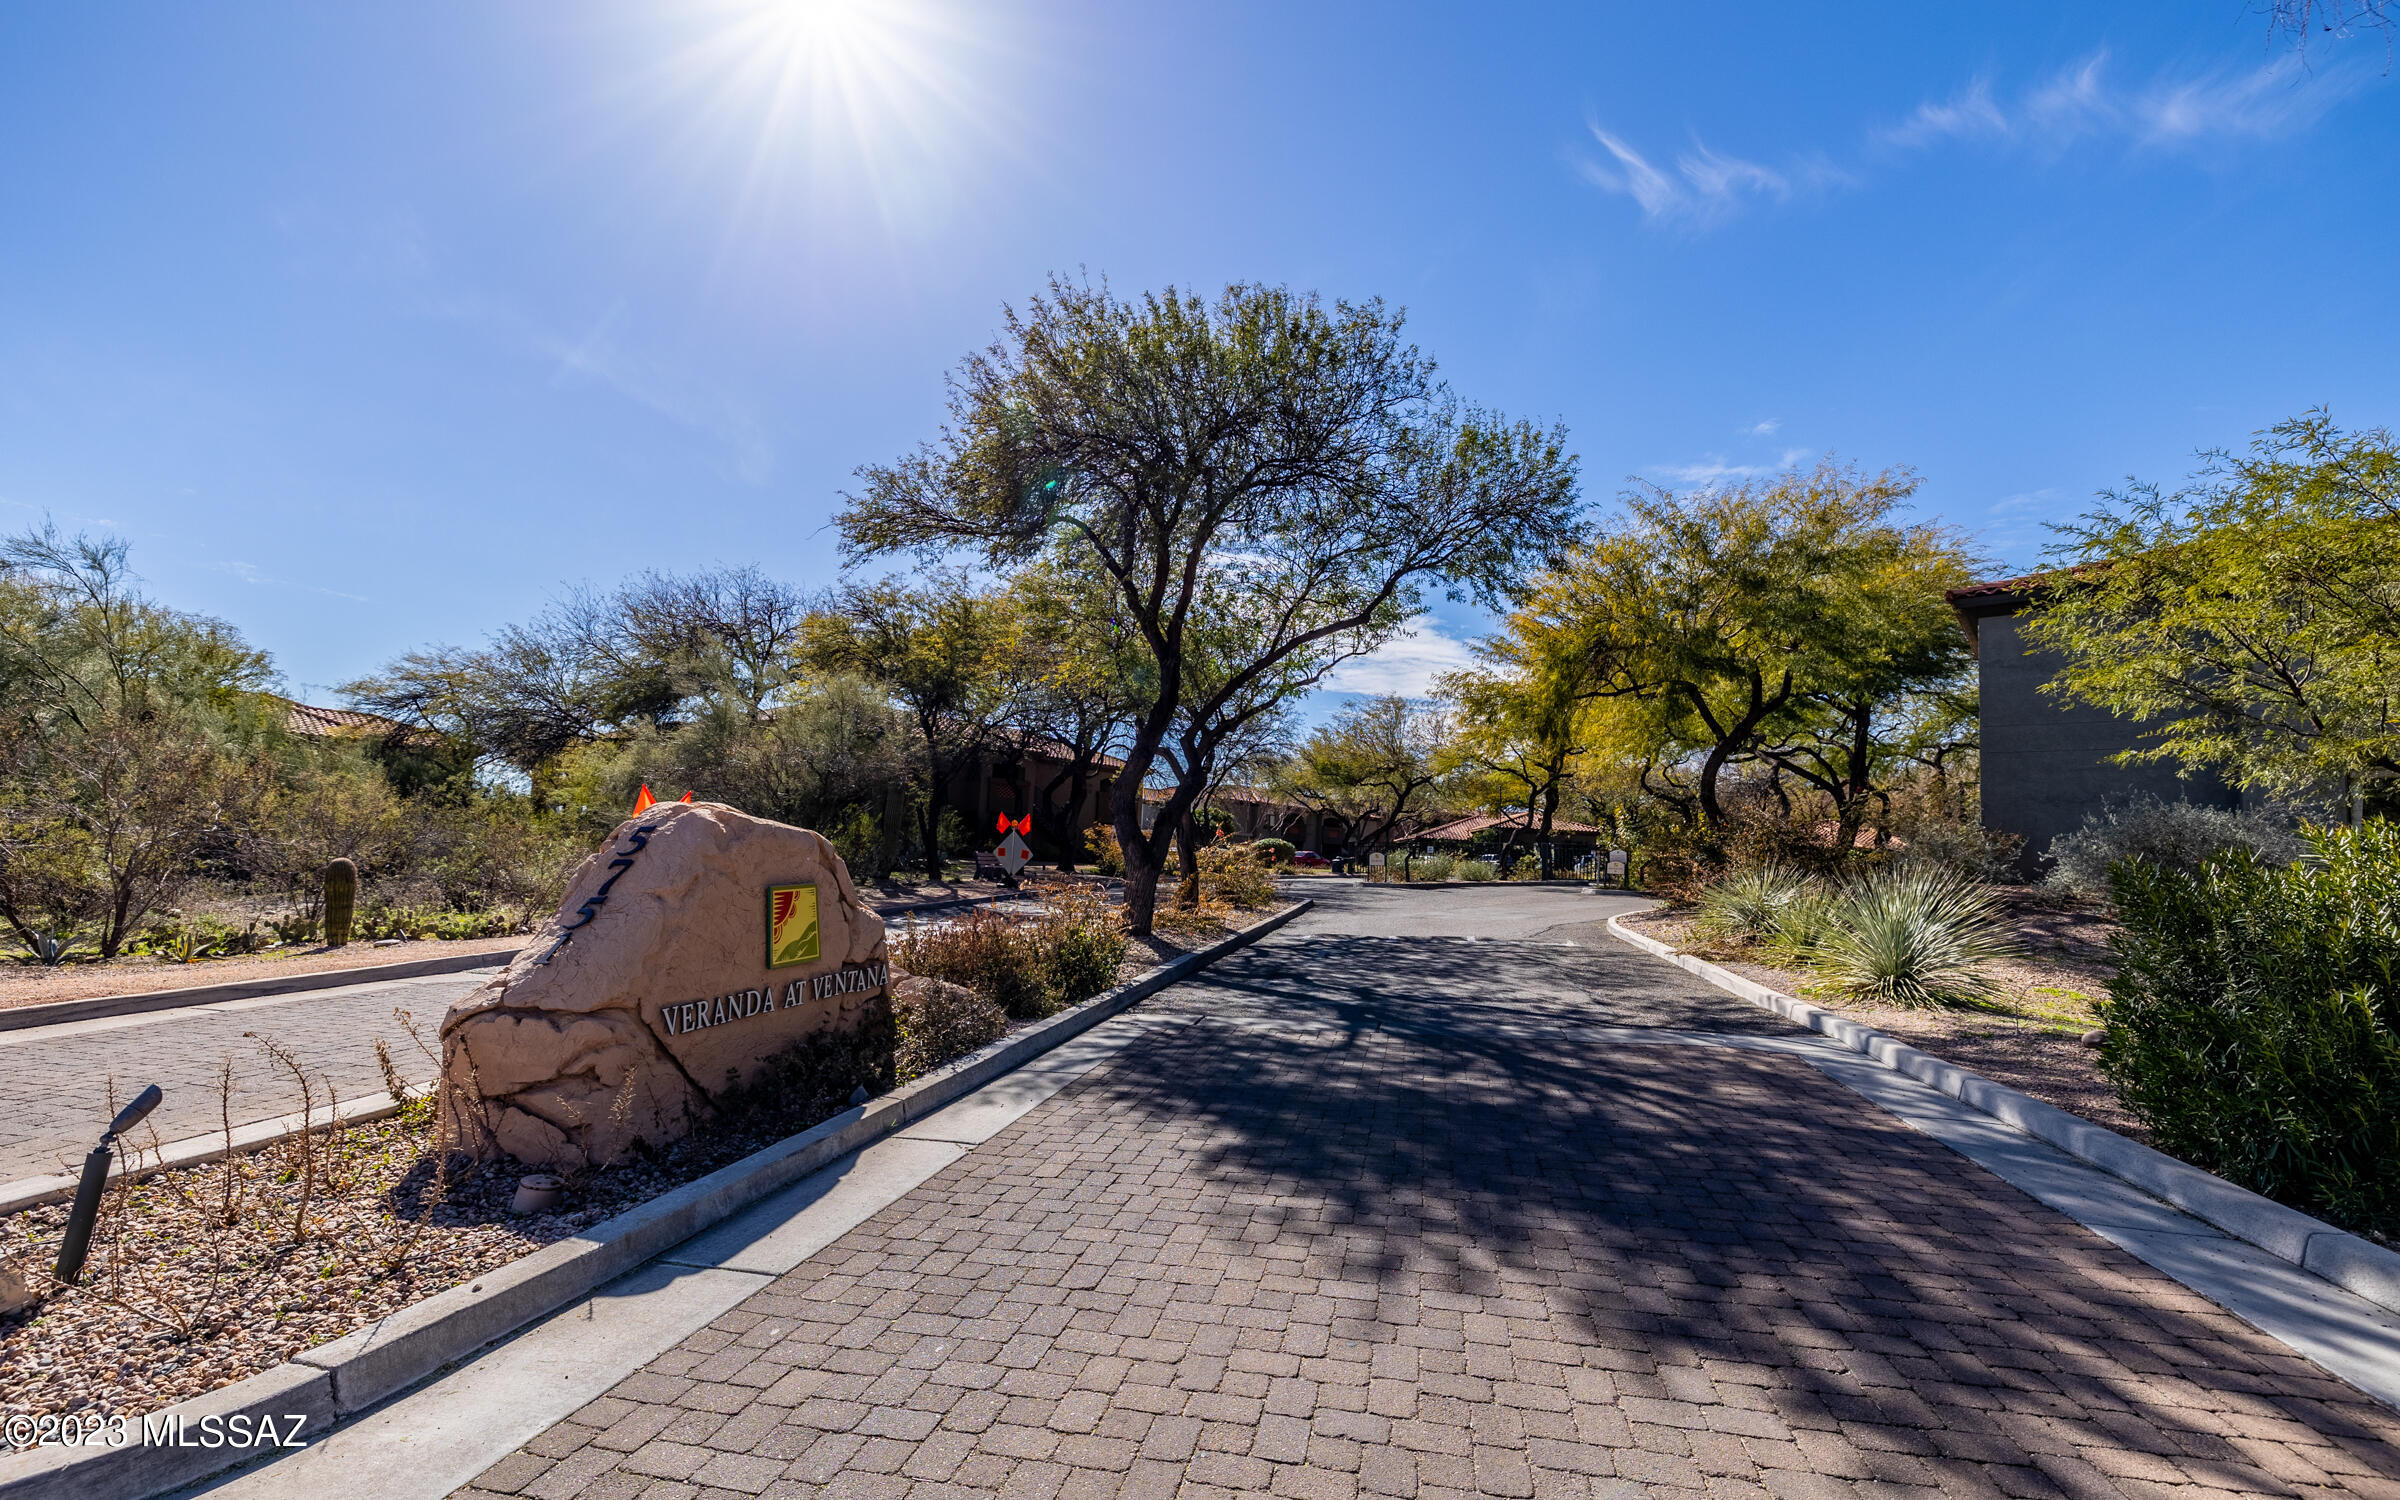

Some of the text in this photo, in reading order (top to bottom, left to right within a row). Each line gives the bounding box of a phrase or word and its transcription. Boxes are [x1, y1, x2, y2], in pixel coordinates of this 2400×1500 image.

[533, 825, 657, 965] 5751
[662, 964, 889, 1036] VERANDA AT VENTANA
